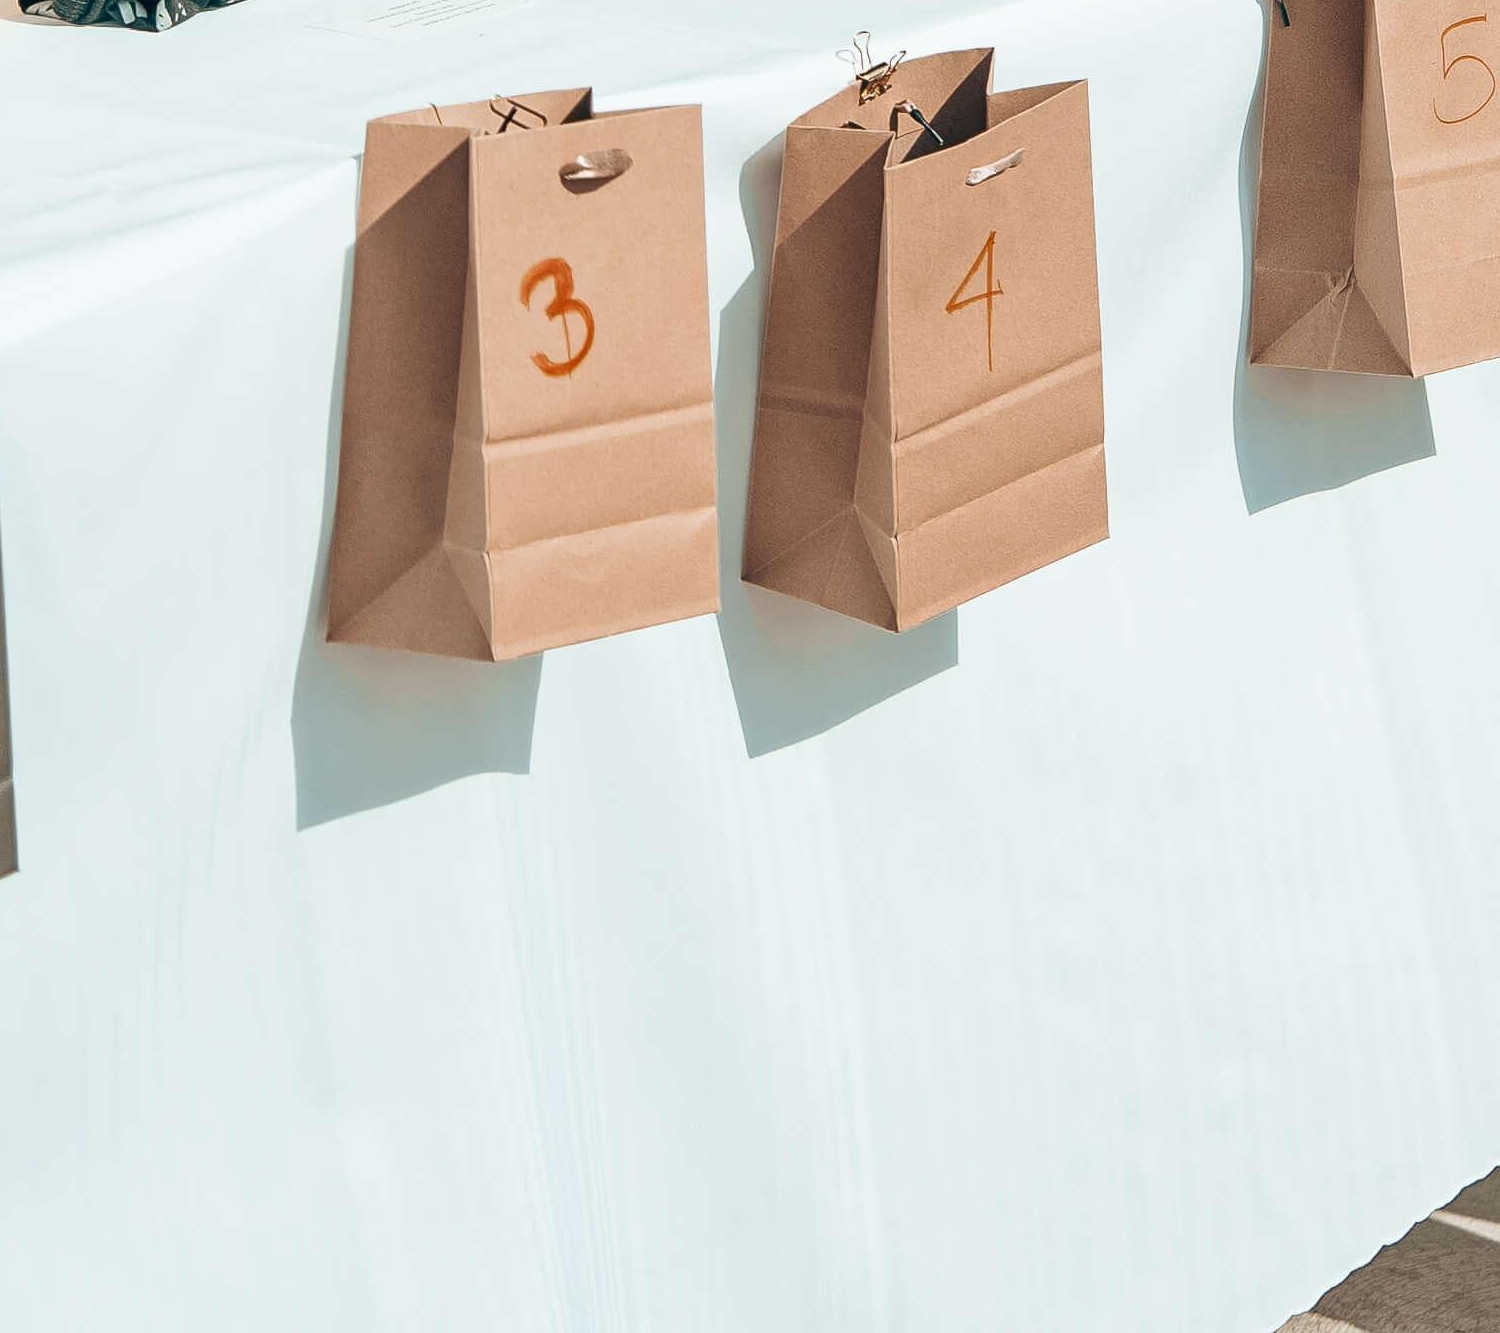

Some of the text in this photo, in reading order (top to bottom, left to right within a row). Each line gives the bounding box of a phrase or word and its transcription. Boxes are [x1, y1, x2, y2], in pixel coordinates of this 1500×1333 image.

[1431, 12, 1498, 125] 5
[518, 256, 595, 379] 3
[945, 230, 1004, 372] 4
